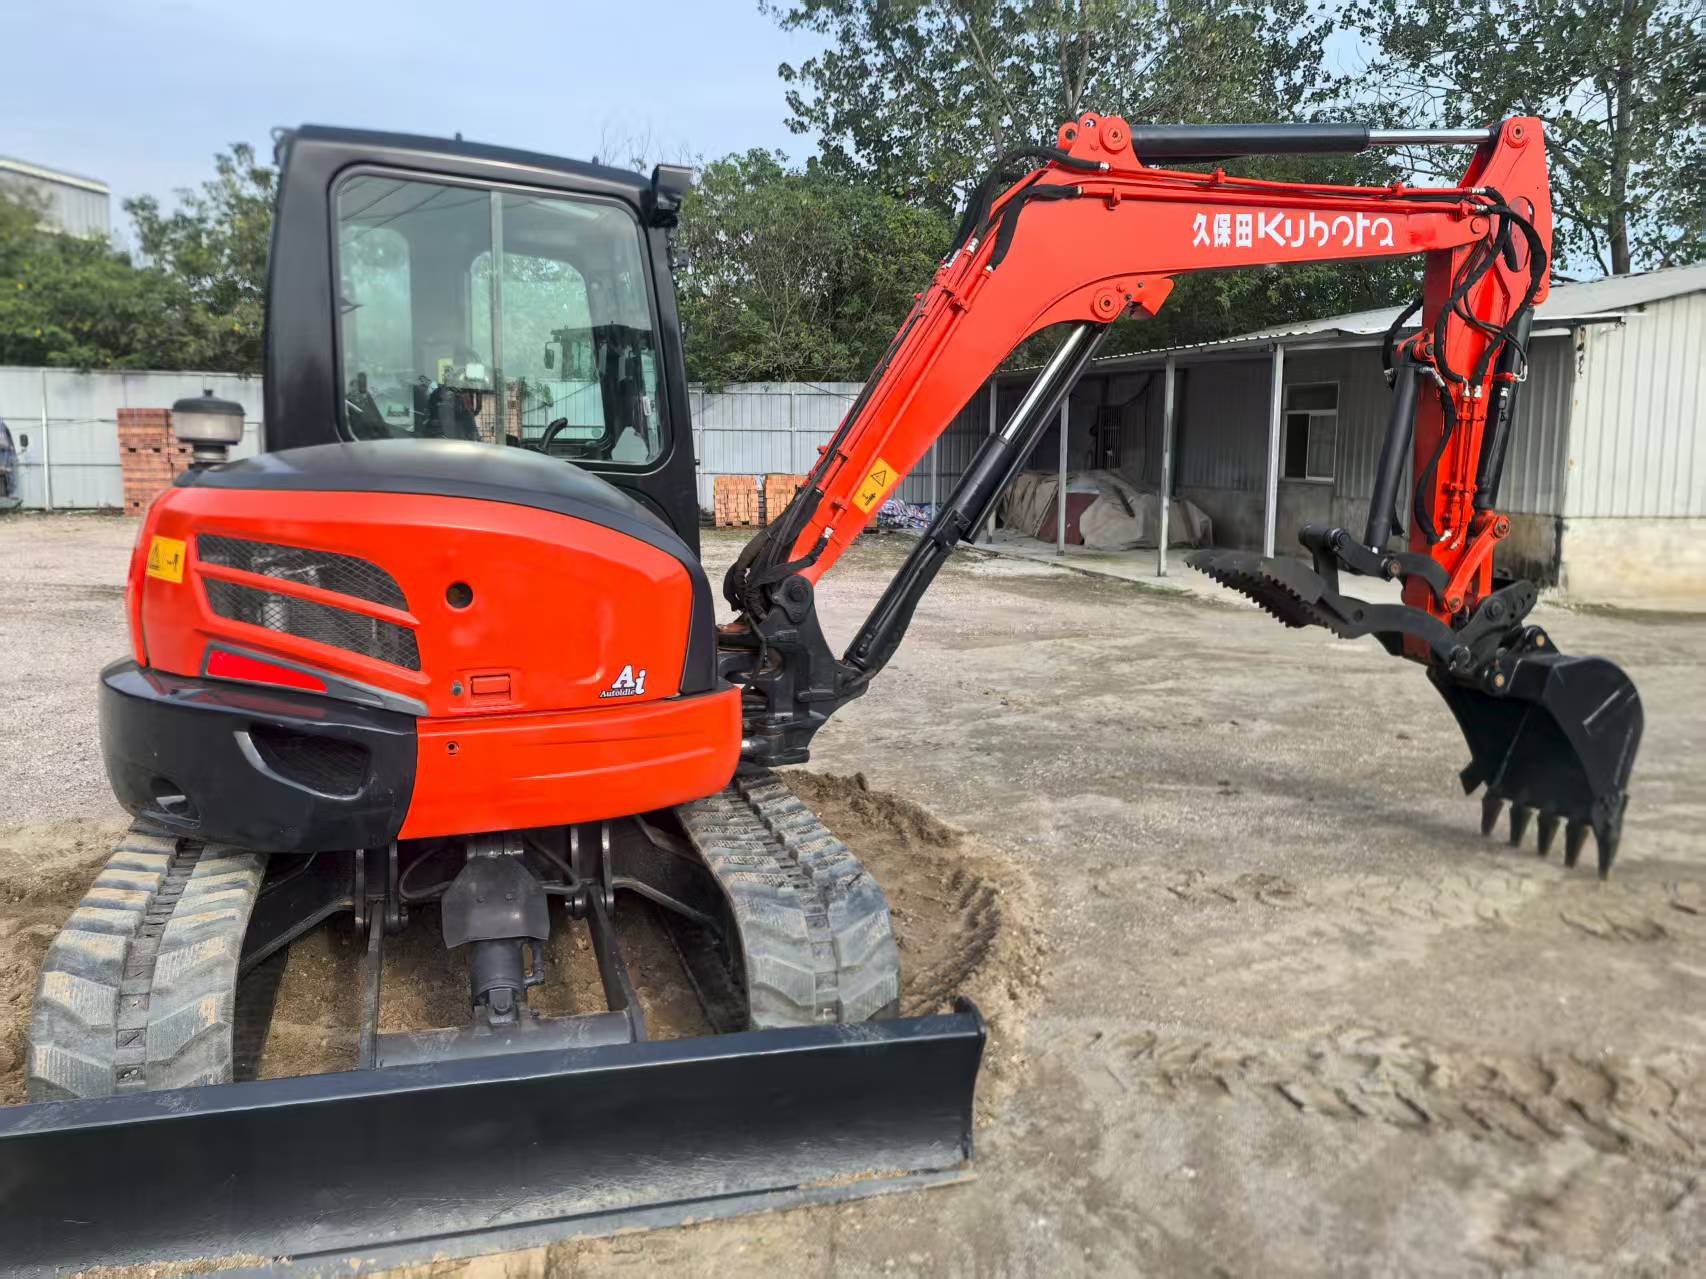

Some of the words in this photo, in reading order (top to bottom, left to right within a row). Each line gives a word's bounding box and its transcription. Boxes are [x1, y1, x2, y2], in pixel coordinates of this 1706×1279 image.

[1192, 212, 1253, 248] 久保田
[1257, 211, 1395, 248] Kubota
[611, 664, 646, 695] Ai
